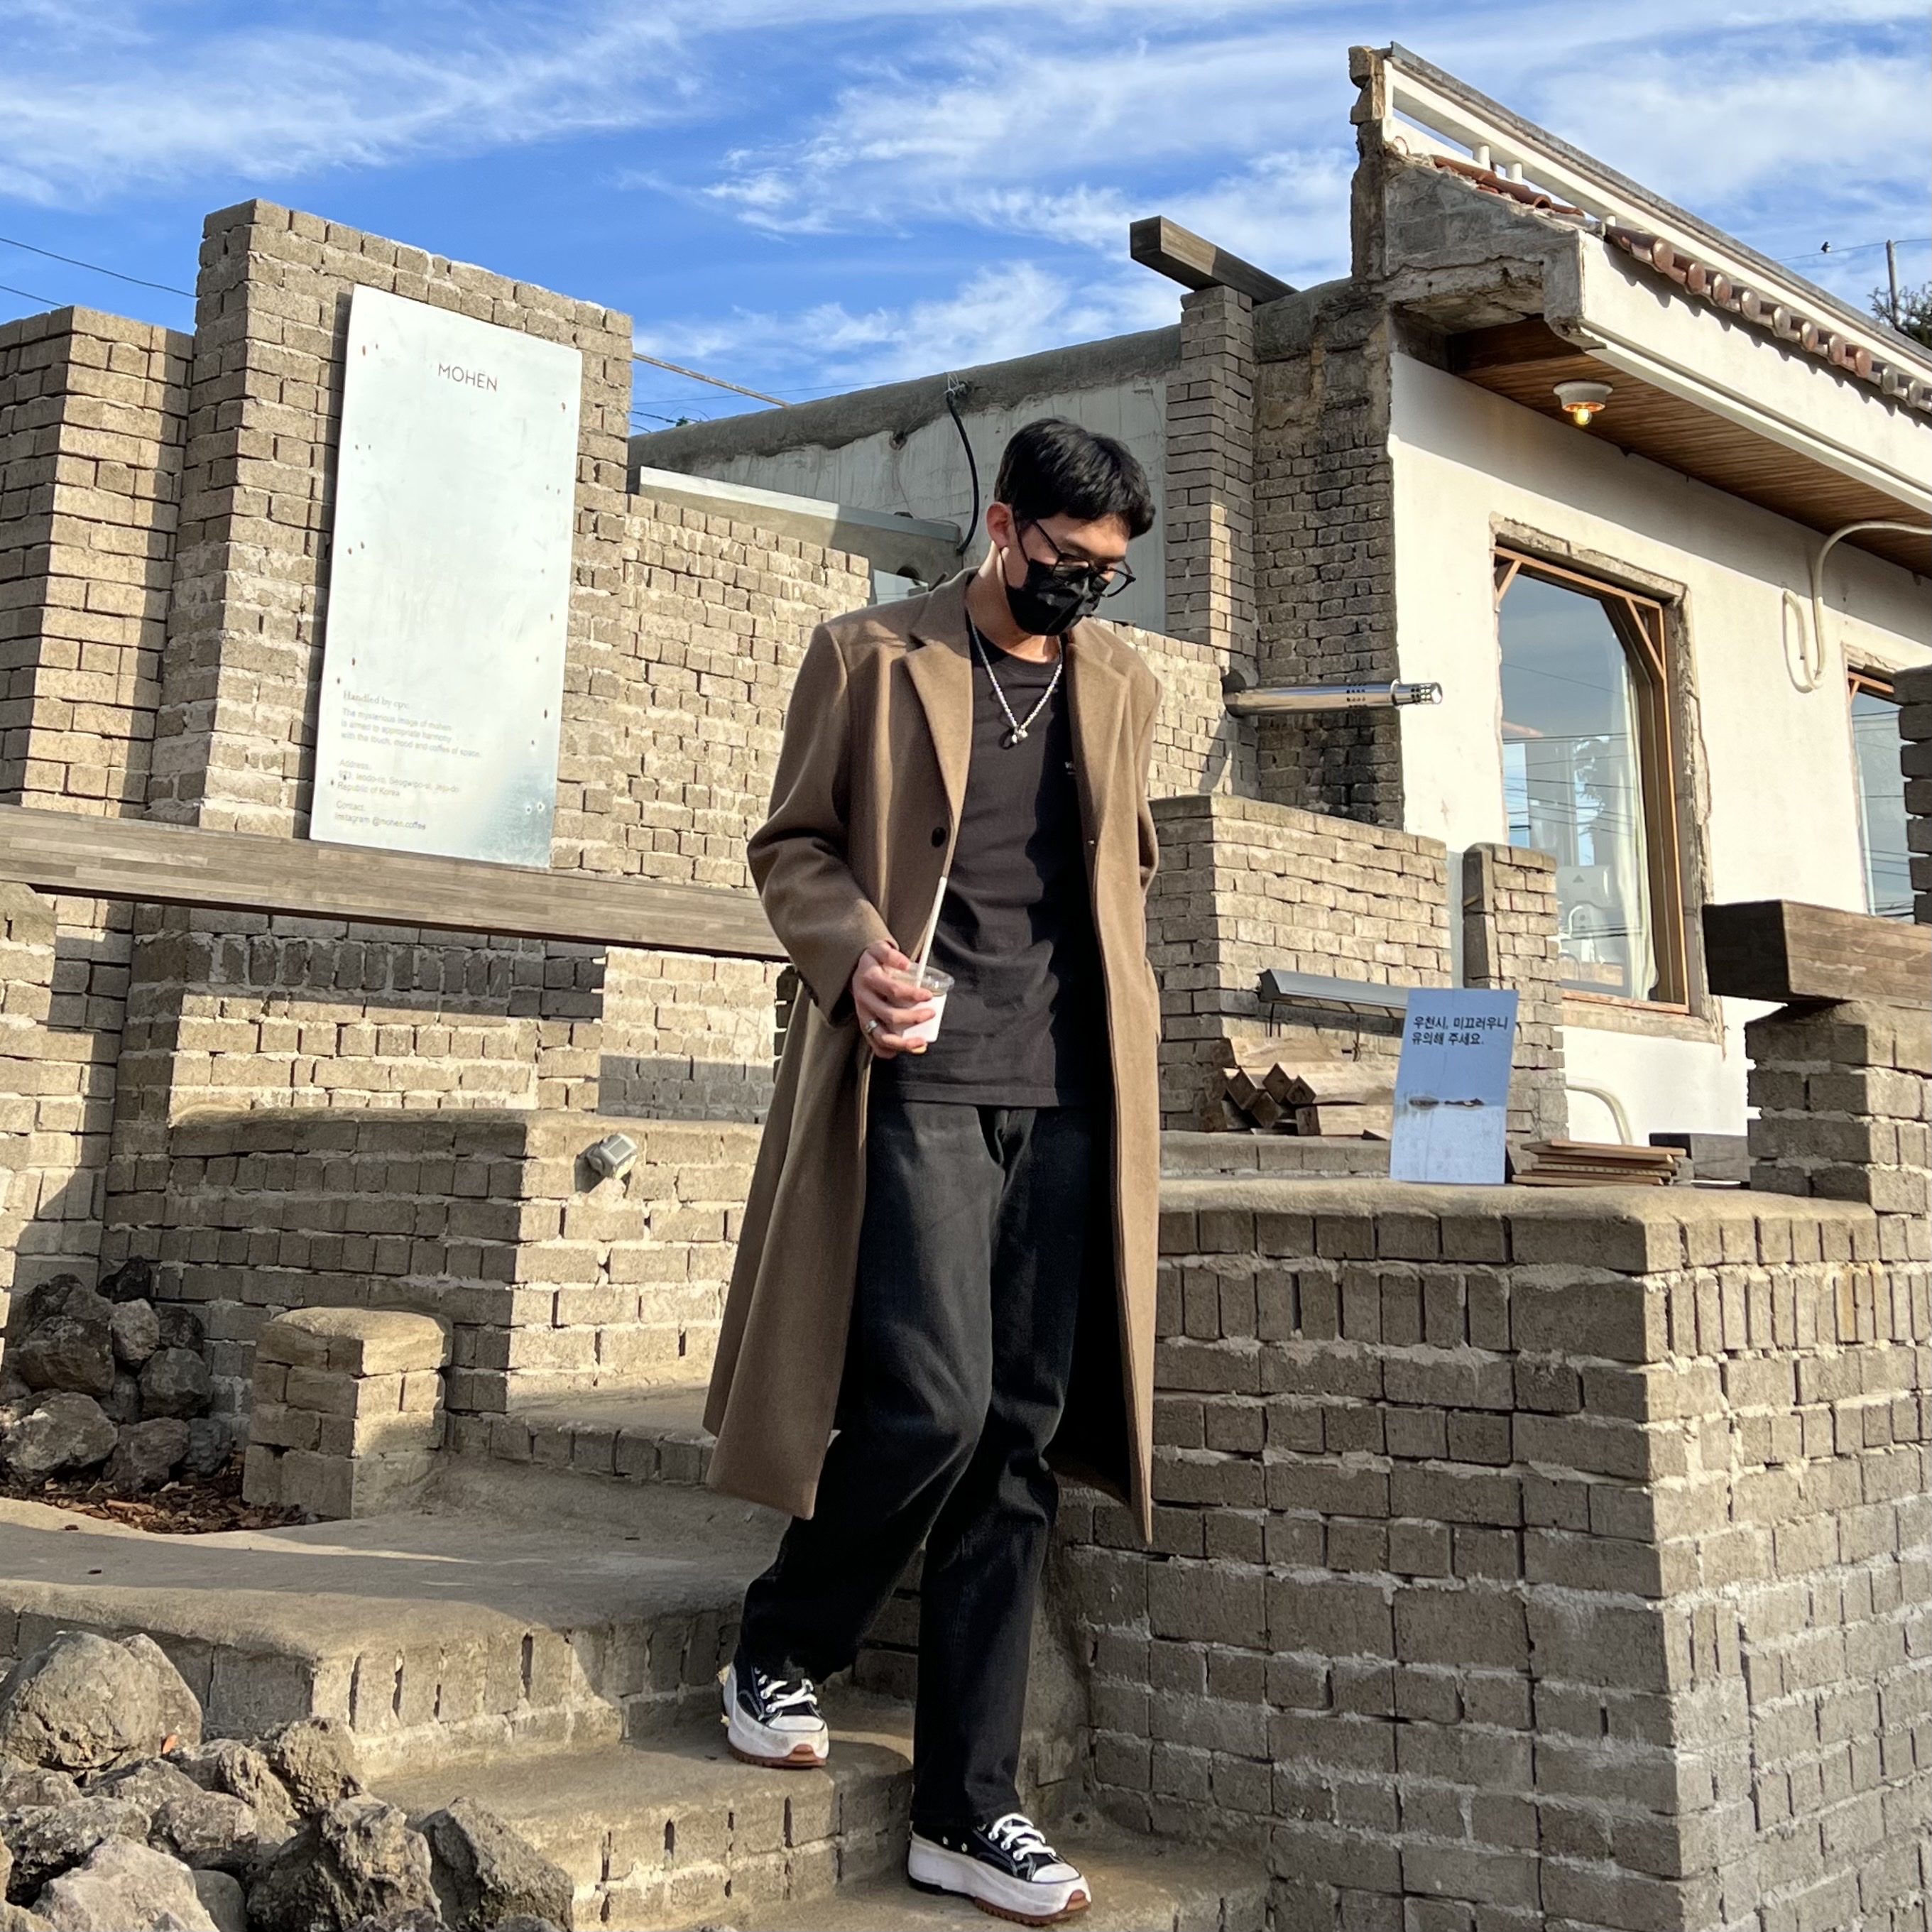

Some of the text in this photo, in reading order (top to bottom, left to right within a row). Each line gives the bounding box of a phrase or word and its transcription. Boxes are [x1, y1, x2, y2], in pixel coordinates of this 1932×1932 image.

[343, 690, 380, 704] Handled
[381, 696, 391, 709] by
[342, 707, 356, 717] The
[378, 787, 400, 797] Korea
[1412, 1031, 1444, 1046] 유의해
